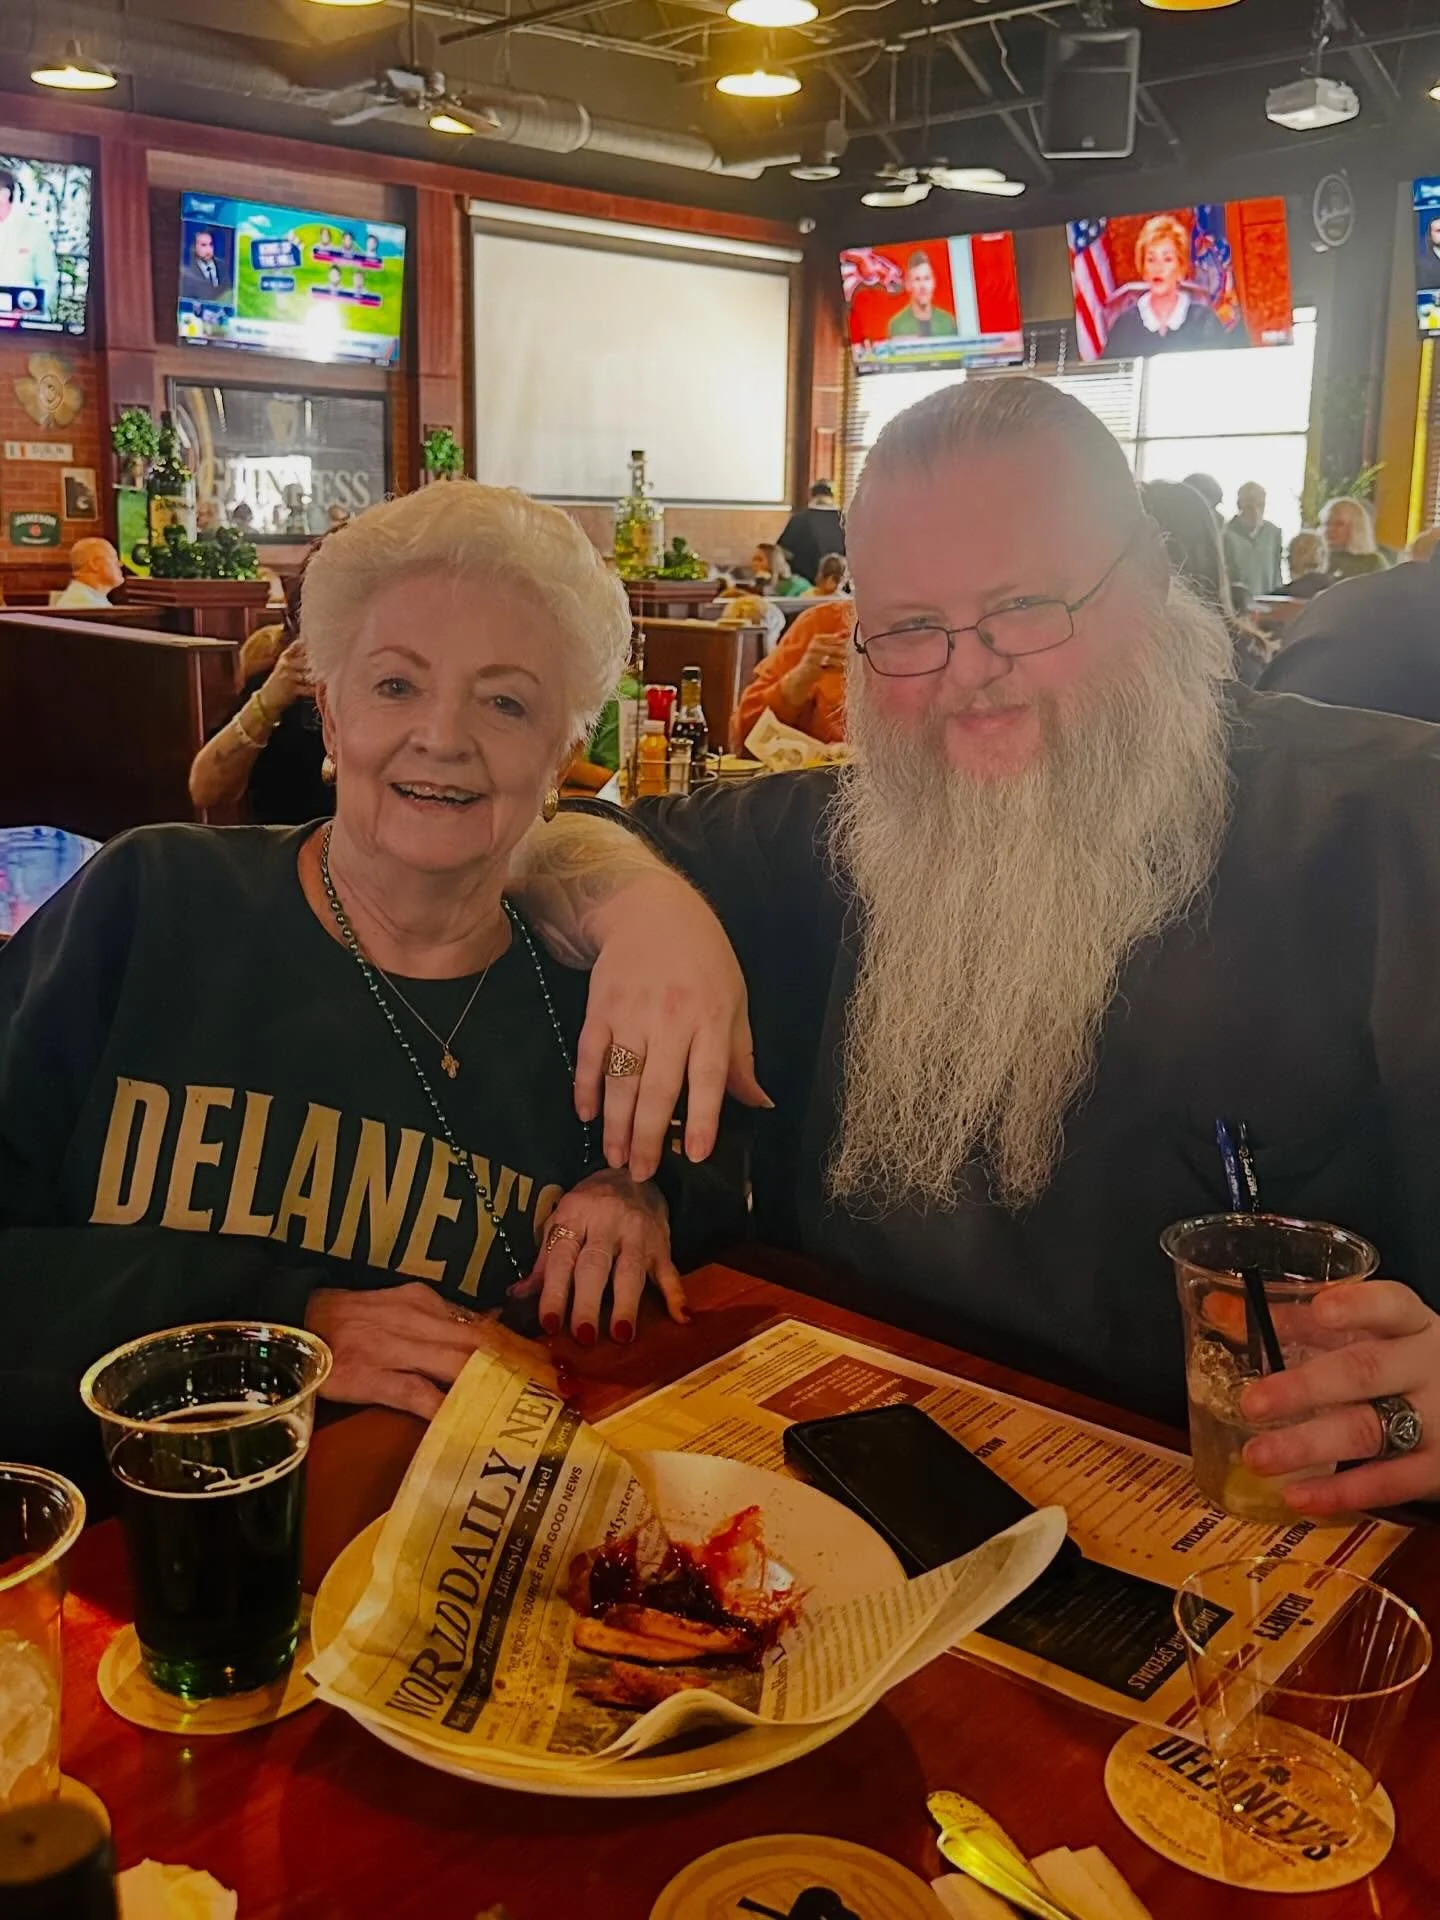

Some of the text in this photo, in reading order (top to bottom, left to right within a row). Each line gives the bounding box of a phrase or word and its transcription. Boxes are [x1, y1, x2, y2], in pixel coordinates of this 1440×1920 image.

[494, 1536, 525, 1599] Lifestyle
[523, 1466, 553, 1513] Travel
[551, 1421, 573, 1453] Sports
[605, 1475, 641, 1542] Mystery
[1171, 1517, 1219, 1553] COCKTAILS
[1281, 1519, 1317, 1547] FROZEN
[521, 1569, 544, 1616] SOURCE
[536, 1543, 553, 1573] FOR
[546, 1503, 569, 1541] GOOD
[562, 1465, 583, 1502] NEWS
[385, 1600, 471, 1720] WORLD
[438, 1447, 526, 1609] DAILY
[1252, 1592, 1314, 1641] DELANEY'S
[1127, 1646, 1177, 1690] SPECIALS
